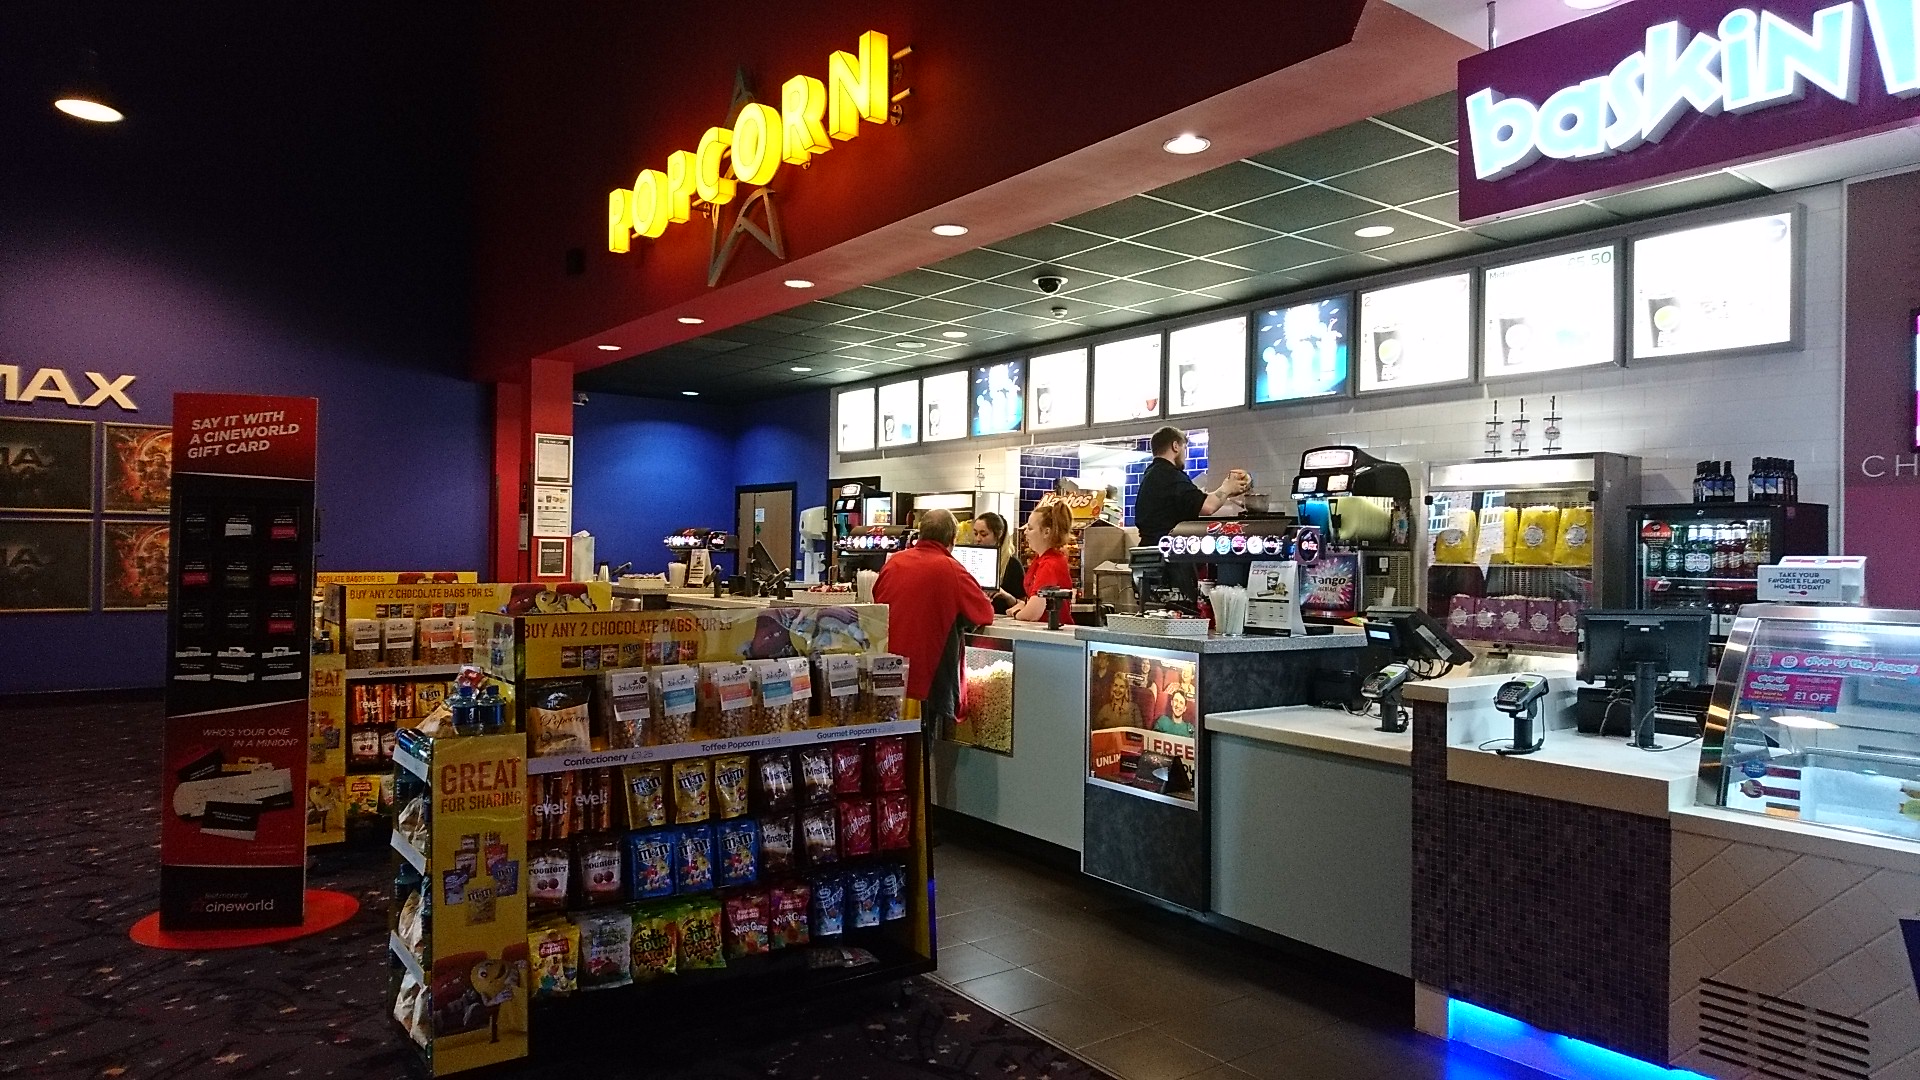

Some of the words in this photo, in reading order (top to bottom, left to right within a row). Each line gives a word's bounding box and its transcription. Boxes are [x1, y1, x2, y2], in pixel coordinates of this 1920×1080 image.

[609, 29, 889, 254] POPCORN
[191, 416, 222, 431] SAY
[224, 415, 240, 427] IT
[243, 410, 285, 425] WITH
[189, 433, 202, 445] A
[203, 423, 300, 443] CINEWORLD
[187, 444, 223, 459] GIFT
[225, 439, 271, 454] CARD
[1040, 491, 1094, 510] Nahos
[1310, 575, 1347, 587] Tango
[350, 589, 368, 599] BUY
[368, 589, 386, 599] ANY
[388, 589, 395, 599] 2
[395, 588, 442, 599] CHOCOLATE
[443, 588, 465, 598] BAGS
[467, 587, 482, 598] FOR
[484, 587, 494, 597] £5
[525, 622, 548, 639] BUY
[551, 621, 577, 638] ANY
[580, 621, 588, 637] 2
[591, 619, 659, 637] CHOCOLATE
[662, 618, 693, 634] BAGS
[695, 617, 717, 632] FOR
[1793, 691, 1806, 701] £1
[1809, 692, 1833, 703] OFF
[539, 714, 586, 730] Popcorn
[202, 728, 235, 737] WHO'S
[238, 728, 266, 737] YOUR
[267, 727, 291, 737] ONE
[816, 730, 848, 741] Gourmet
[848, 726, 878, 738] Popcorn
[232, 739, 245, 748] IN
[244, 739, 254, 748] A
[256, 738, 299, 748] MINION?
[701, 742, 727, 753] Toffee
[727, 739, 760, 752] Popcorn
[1153, 738, 1195, 762] FREE
[563, 753, 628, 767] Confectionery
[440, 757, 522, 796] GREAT
[441, 796, 466, 814] FOR
[469, 791, 522, 811] SHARING
[205, 898, 274, 913] cineworld
[684, 927, 718, 944] SOUR
[634, 937, 670, 952] SOUR
[683, 935, 722, 959] PATCH
[633, 947, 674, 967] PATCH
